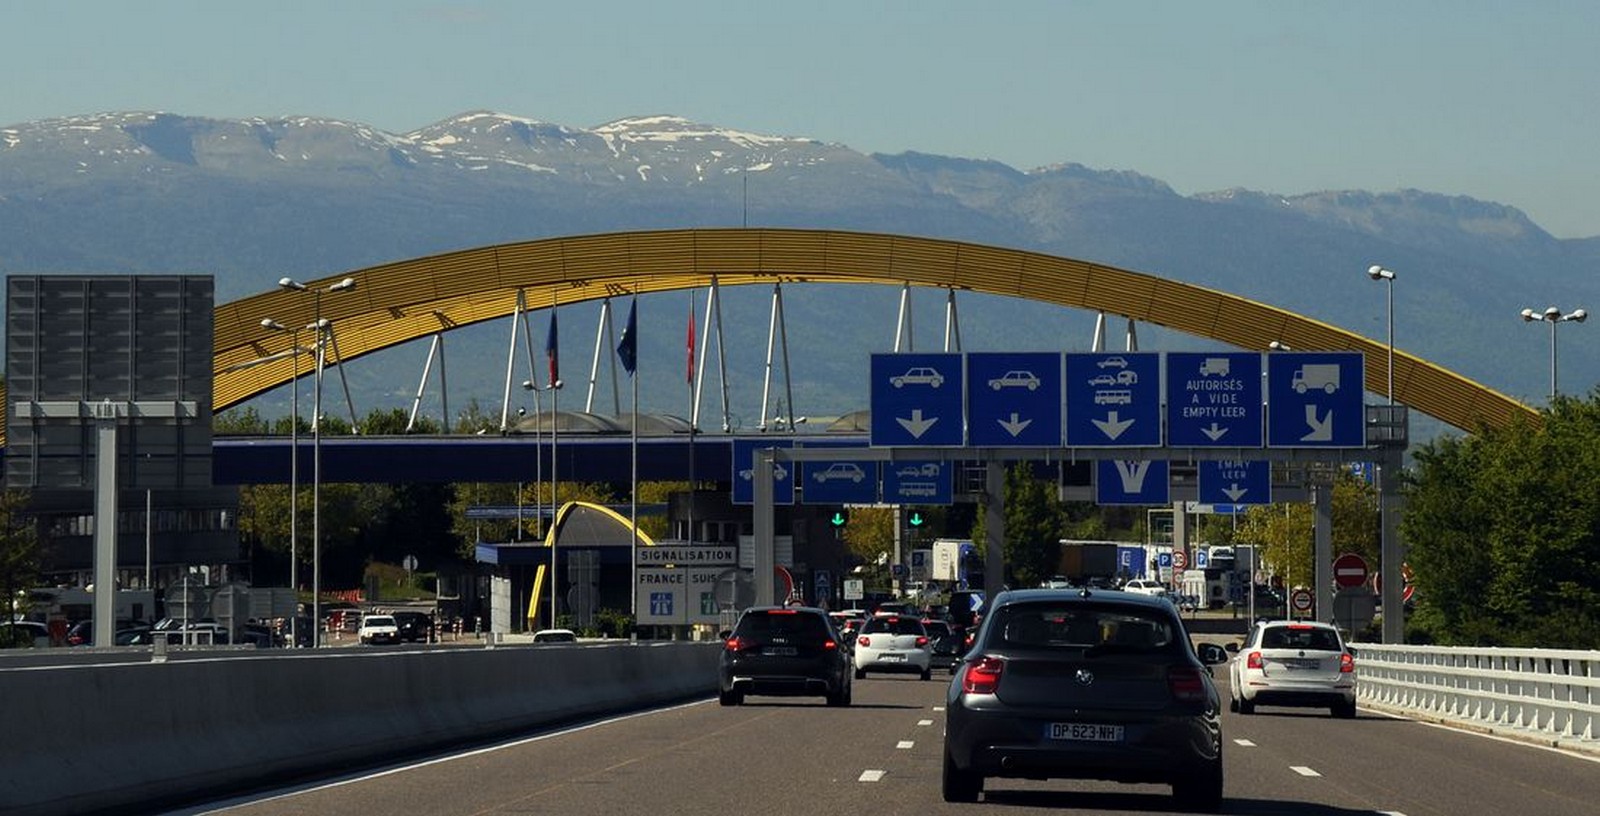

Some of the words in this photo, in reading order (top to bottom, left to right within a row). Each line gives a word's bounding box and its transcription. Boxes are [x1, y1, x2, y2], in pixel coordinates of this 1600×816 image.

[1186, 378, 1244, 391] AUTORISÉS
[1191, 393, 1200, 404] A
[1209, 393, 1238, 404] VIDE
[1183, 406, 1219, 418] EMPTY
[1221, 406, 1246, 418] LEER
[641, 550, 733, 561] SIGNALISATION
[639, 574, 684, 584] FRANCE
